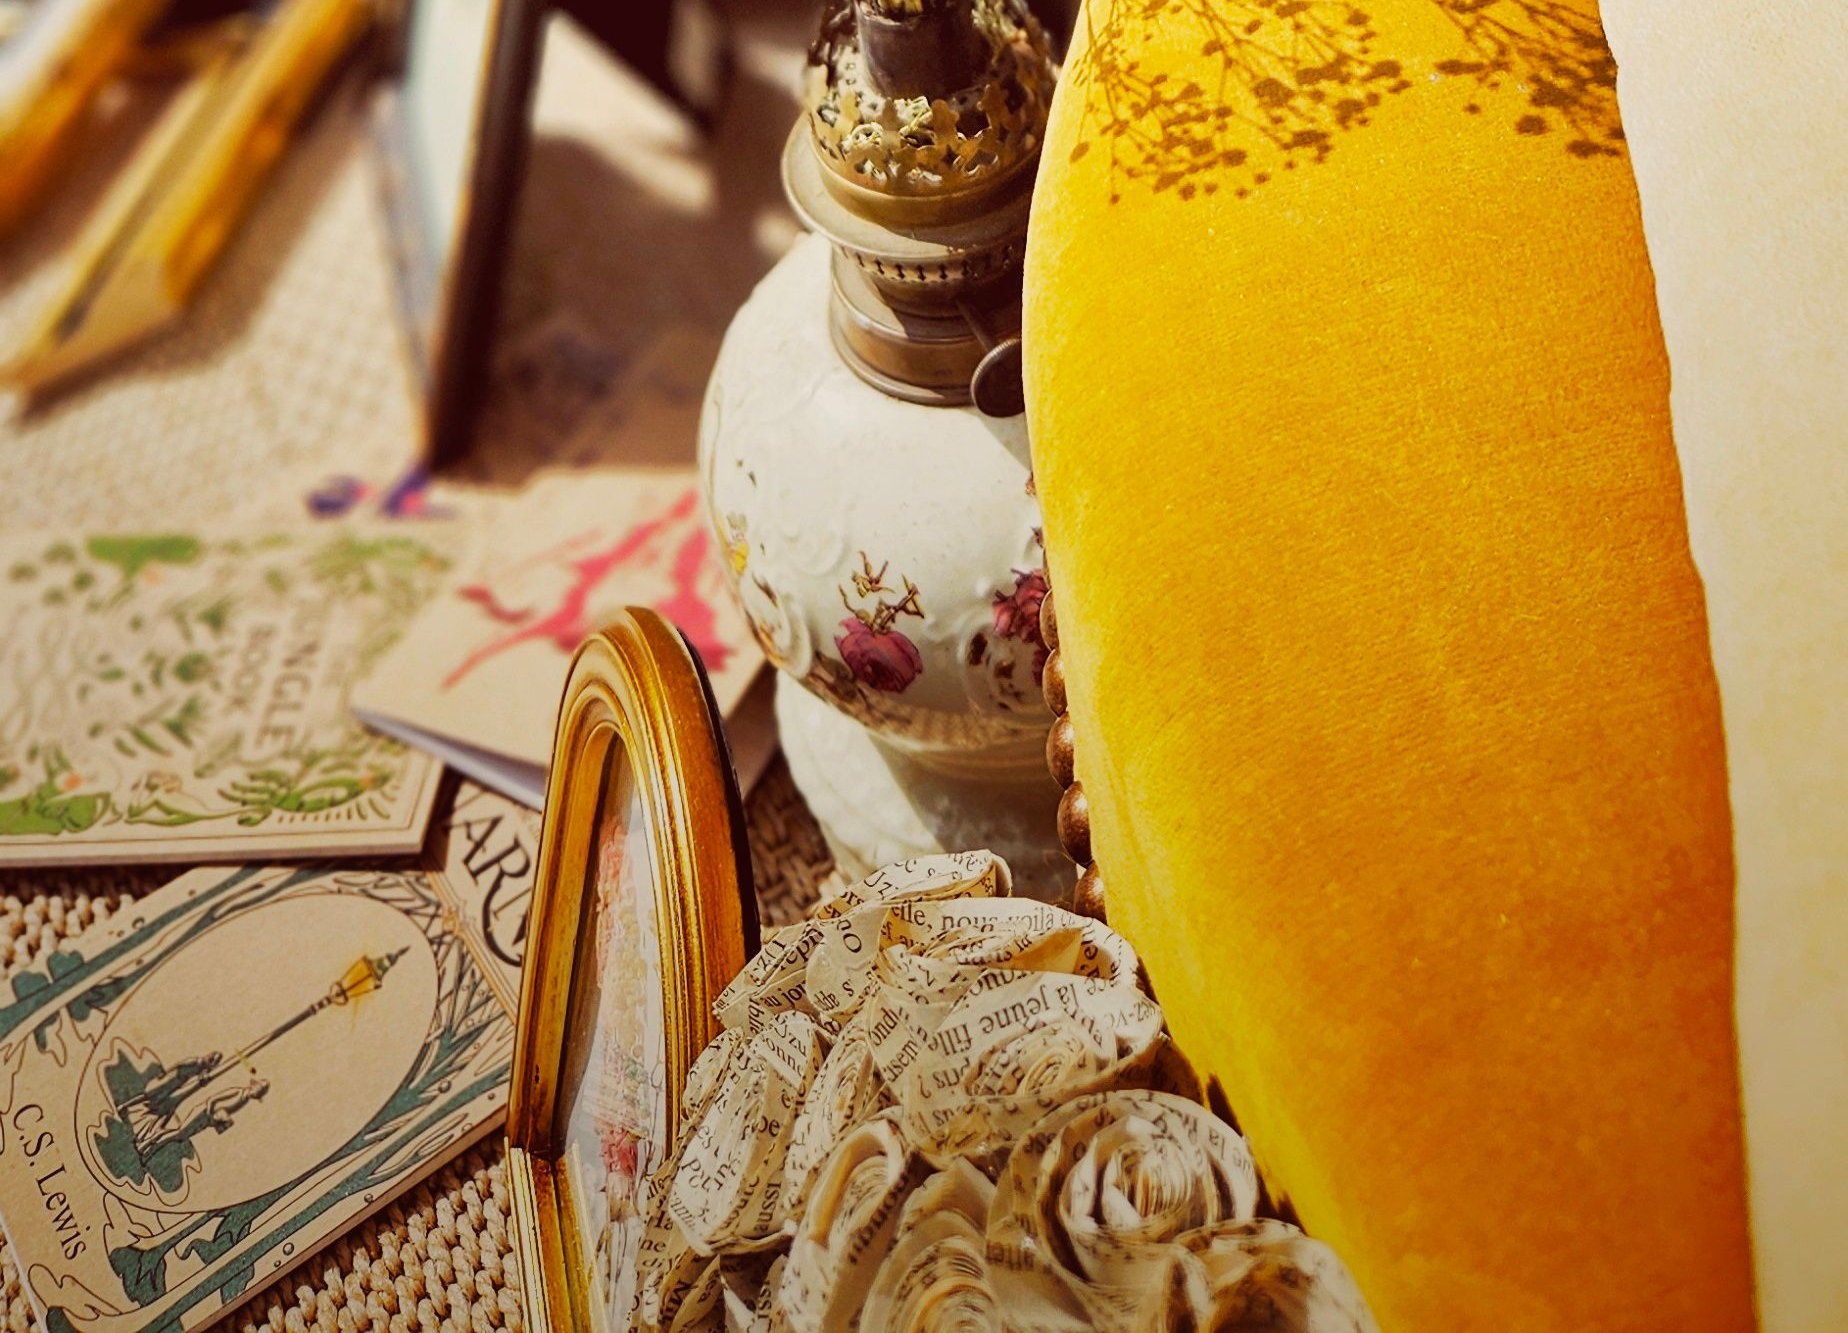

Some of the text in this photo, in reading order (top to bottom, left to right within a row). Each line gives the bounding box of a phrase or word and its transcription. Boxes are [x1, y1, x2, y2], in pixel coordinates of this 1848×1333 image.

[978, 984, 1051, 1033] jeune
[928, 1023, 972, 1057] fille
[13, 1104, 91, 1261] C.S. Lewis
